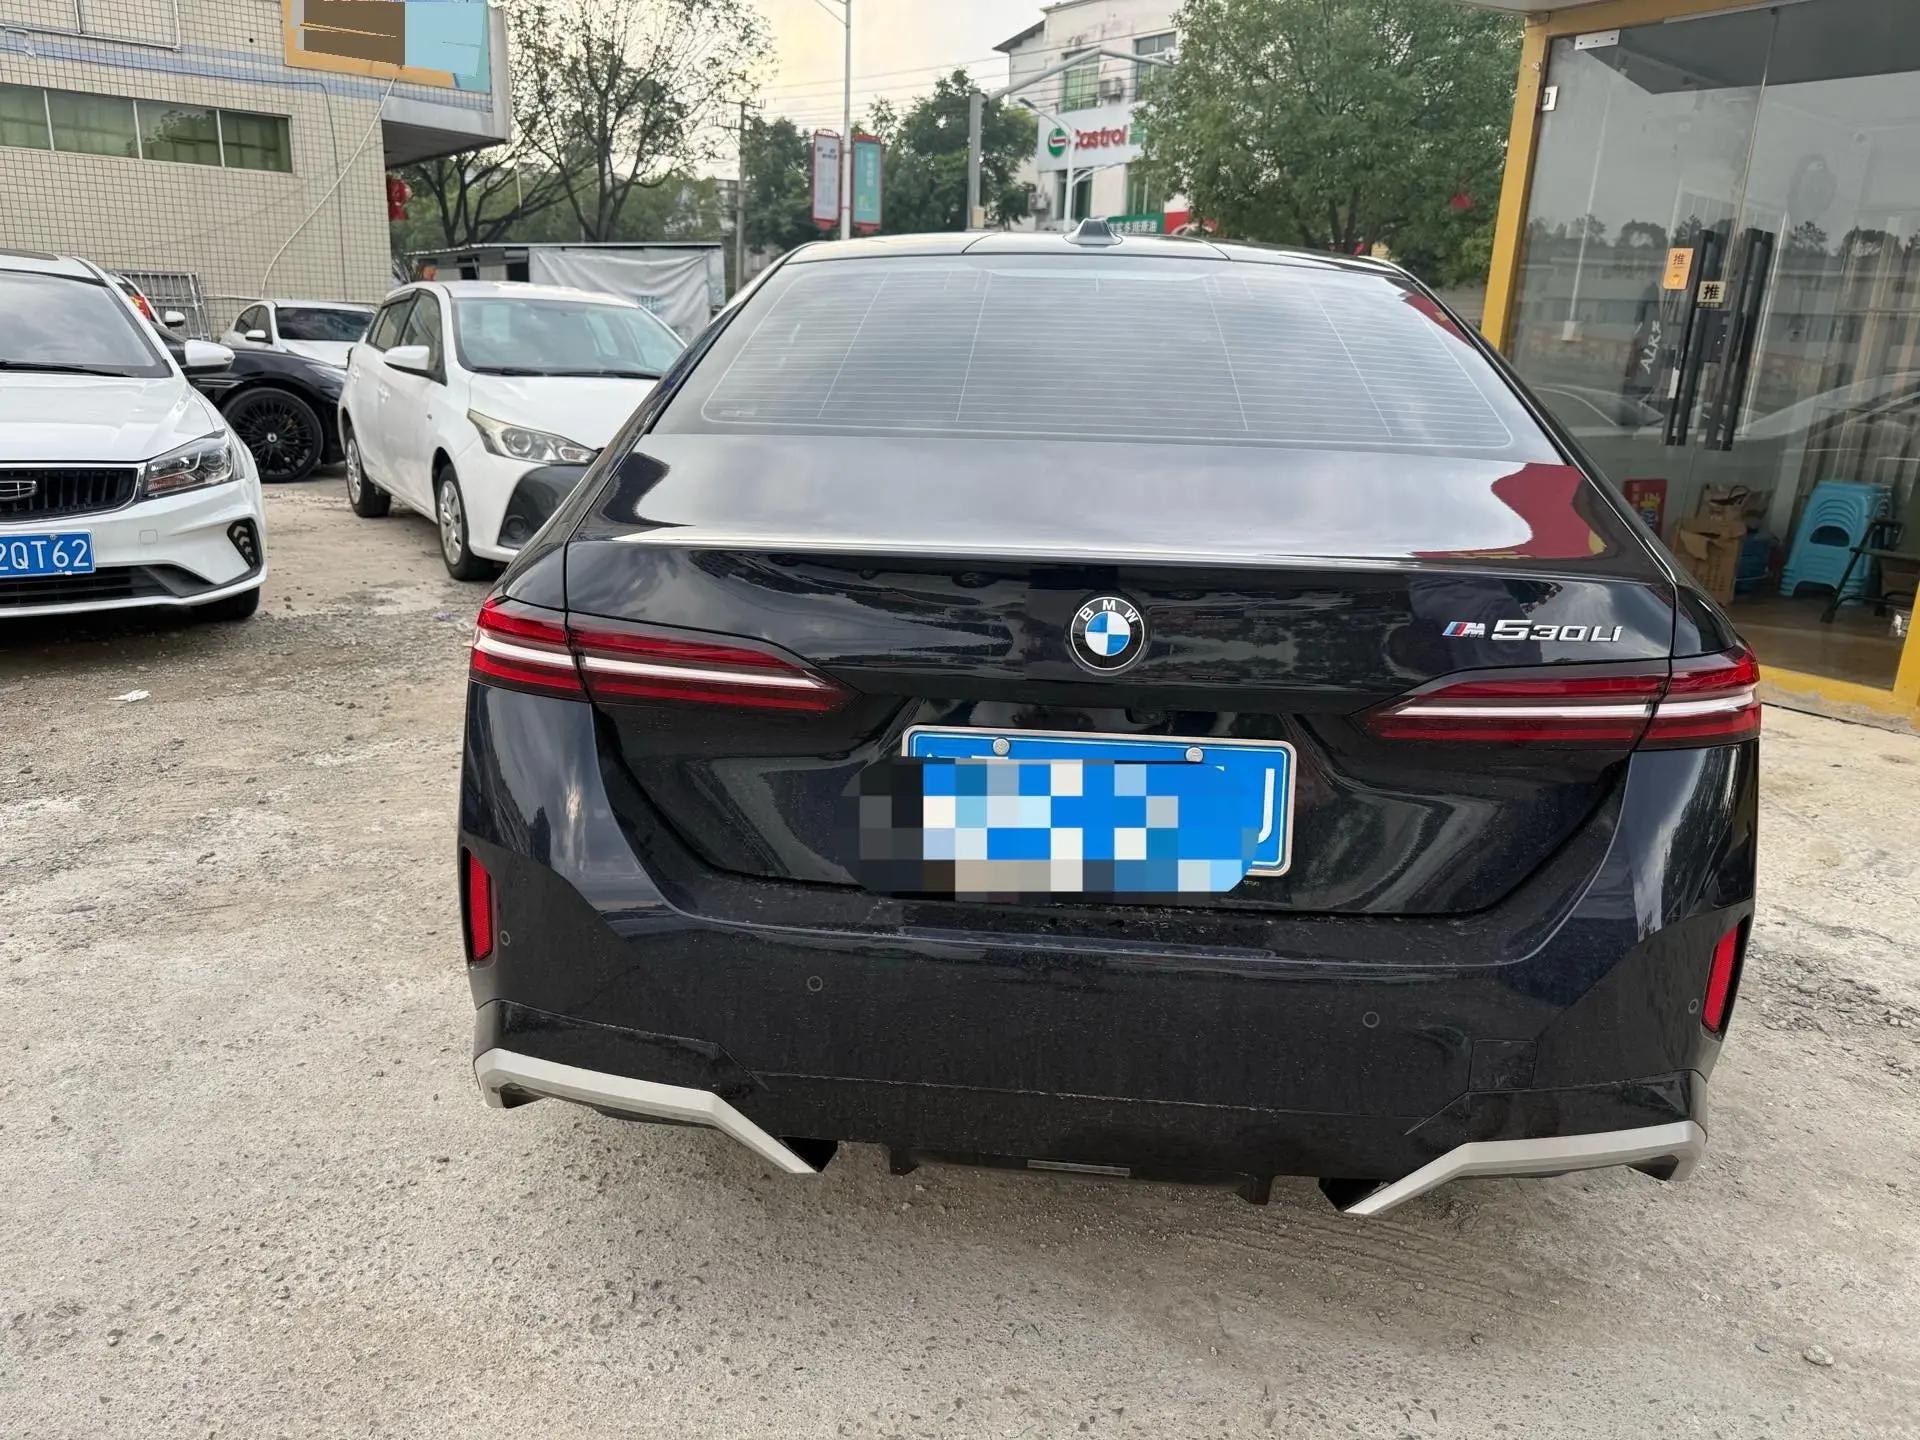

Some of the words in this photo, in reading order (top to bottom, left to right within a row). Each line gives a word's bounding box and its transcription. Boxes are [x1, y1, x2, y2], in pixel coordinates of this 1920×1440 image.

[1672, 252, 1687, 266] 推
[1702, 282, 1721, 300] 推
[1079, 599, 1139, 624] BMW
